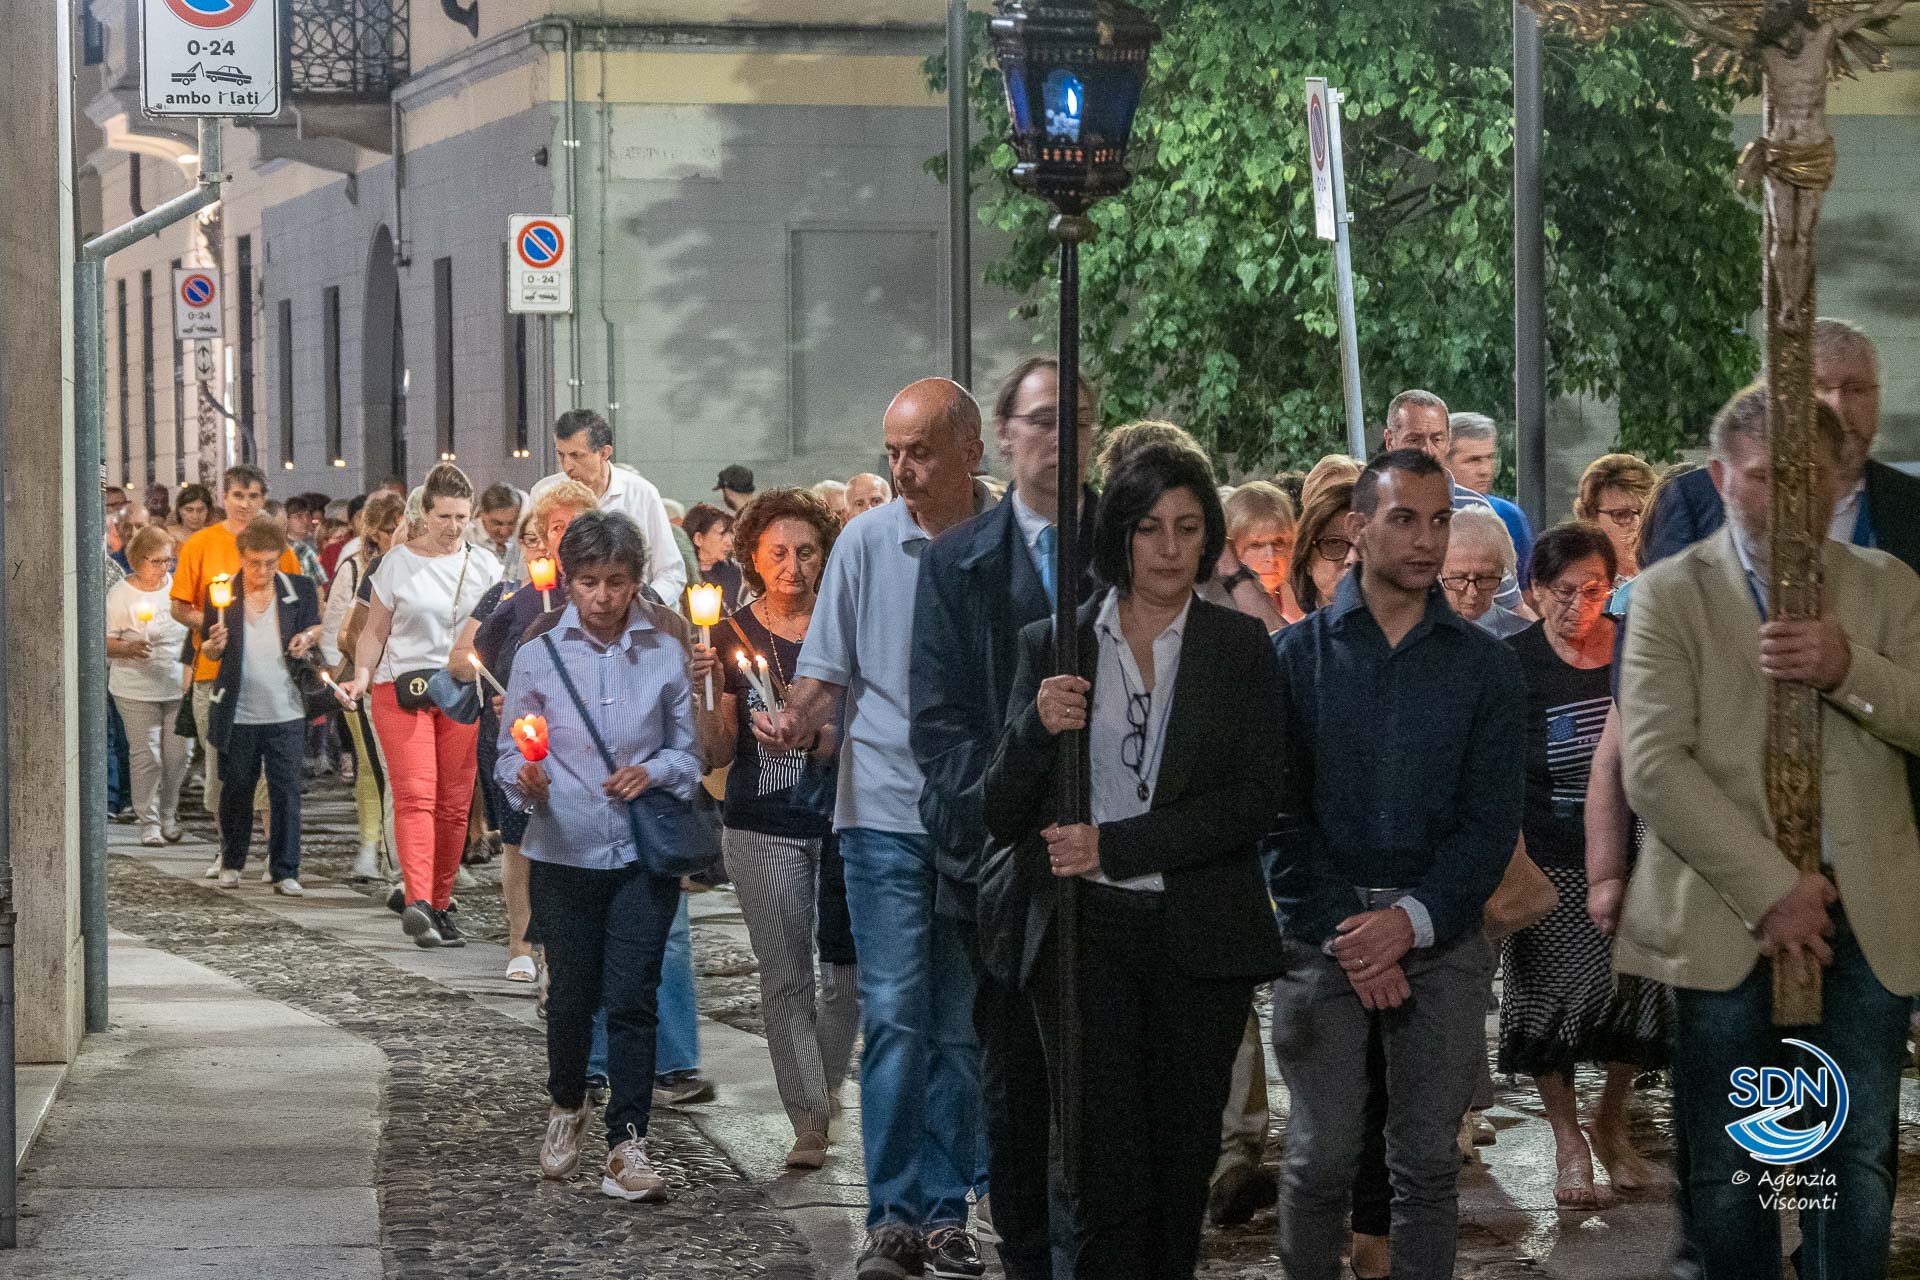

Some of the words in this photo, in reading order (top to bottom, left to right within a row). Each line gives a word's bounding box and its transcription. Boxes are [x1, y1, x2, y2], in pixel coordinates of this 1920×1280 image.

[187, 40, 236, 56] 0-24
[165, 90, 211, 104] ambo
[218, 91, 223, 104] i
[230, 91, 259, 104] lati
